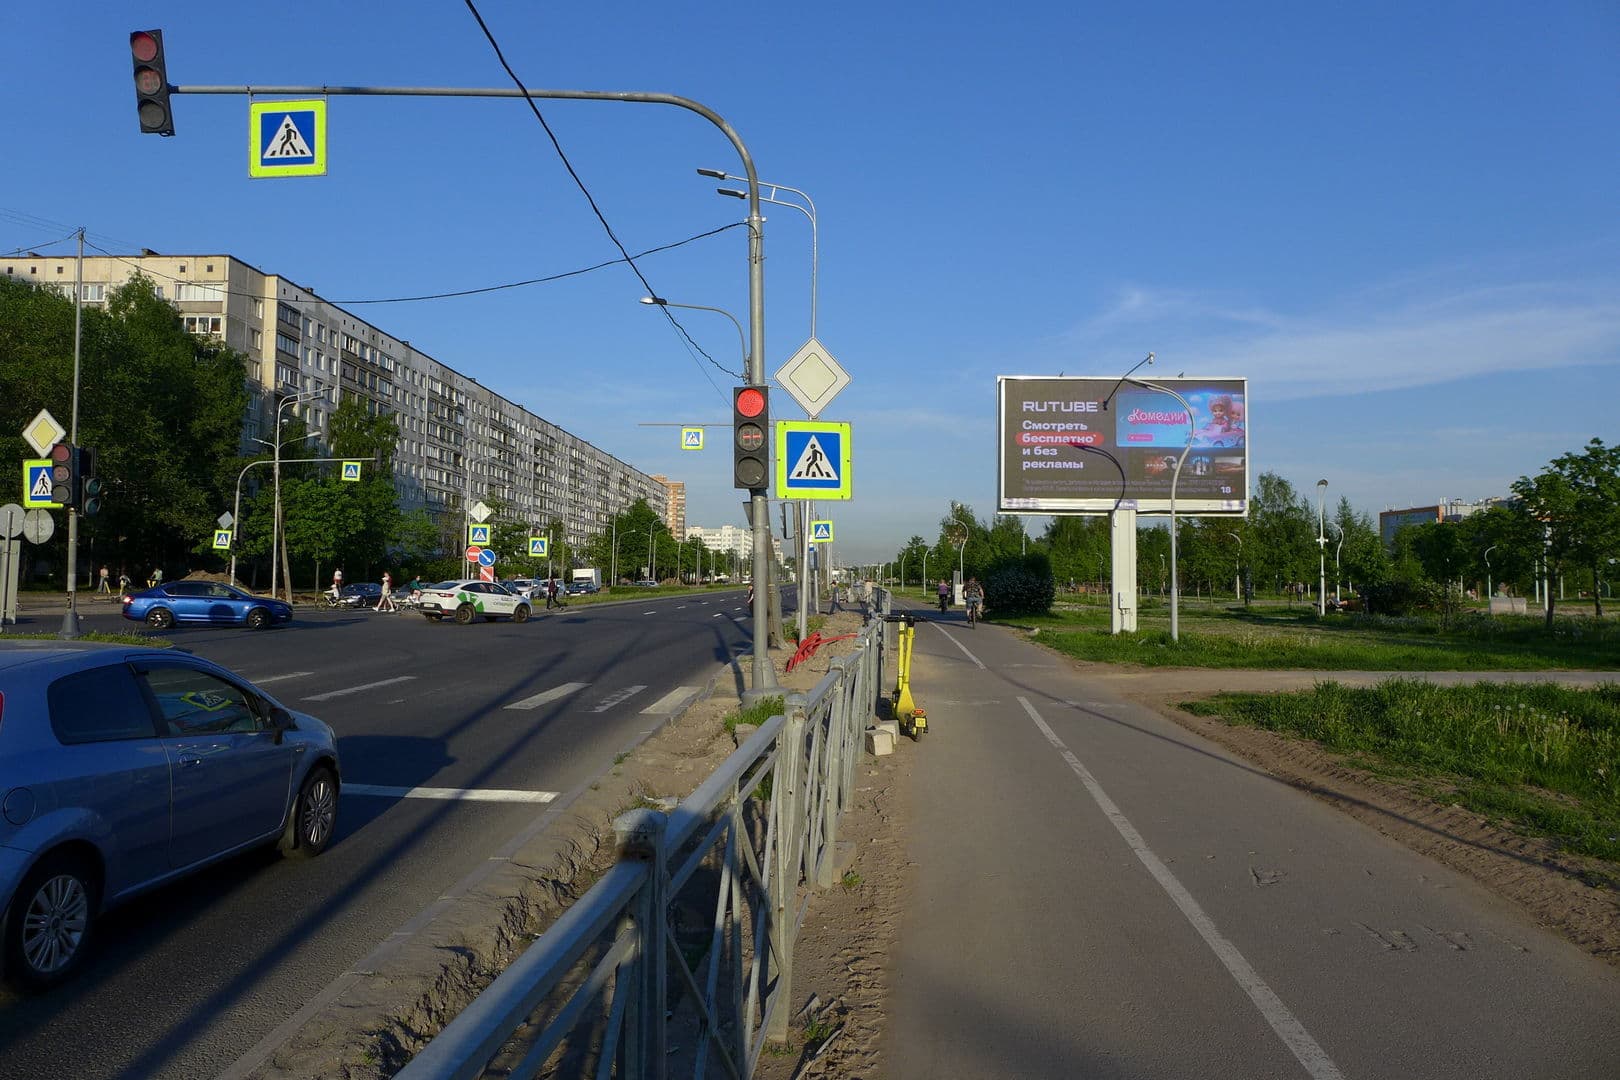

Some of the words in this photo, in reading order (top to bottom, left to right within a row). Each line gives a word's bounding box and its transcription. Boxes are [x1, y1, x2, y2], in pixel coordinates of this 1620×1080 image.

[1022, 401, 1098, 412] RUTUBE
[1022, 420, 1088, 432] Смотреть
[1022, 448, 1031, 456] и
[1033, 446, 1058, 456] без
[1022, 461, 1084, 470] рекламы
